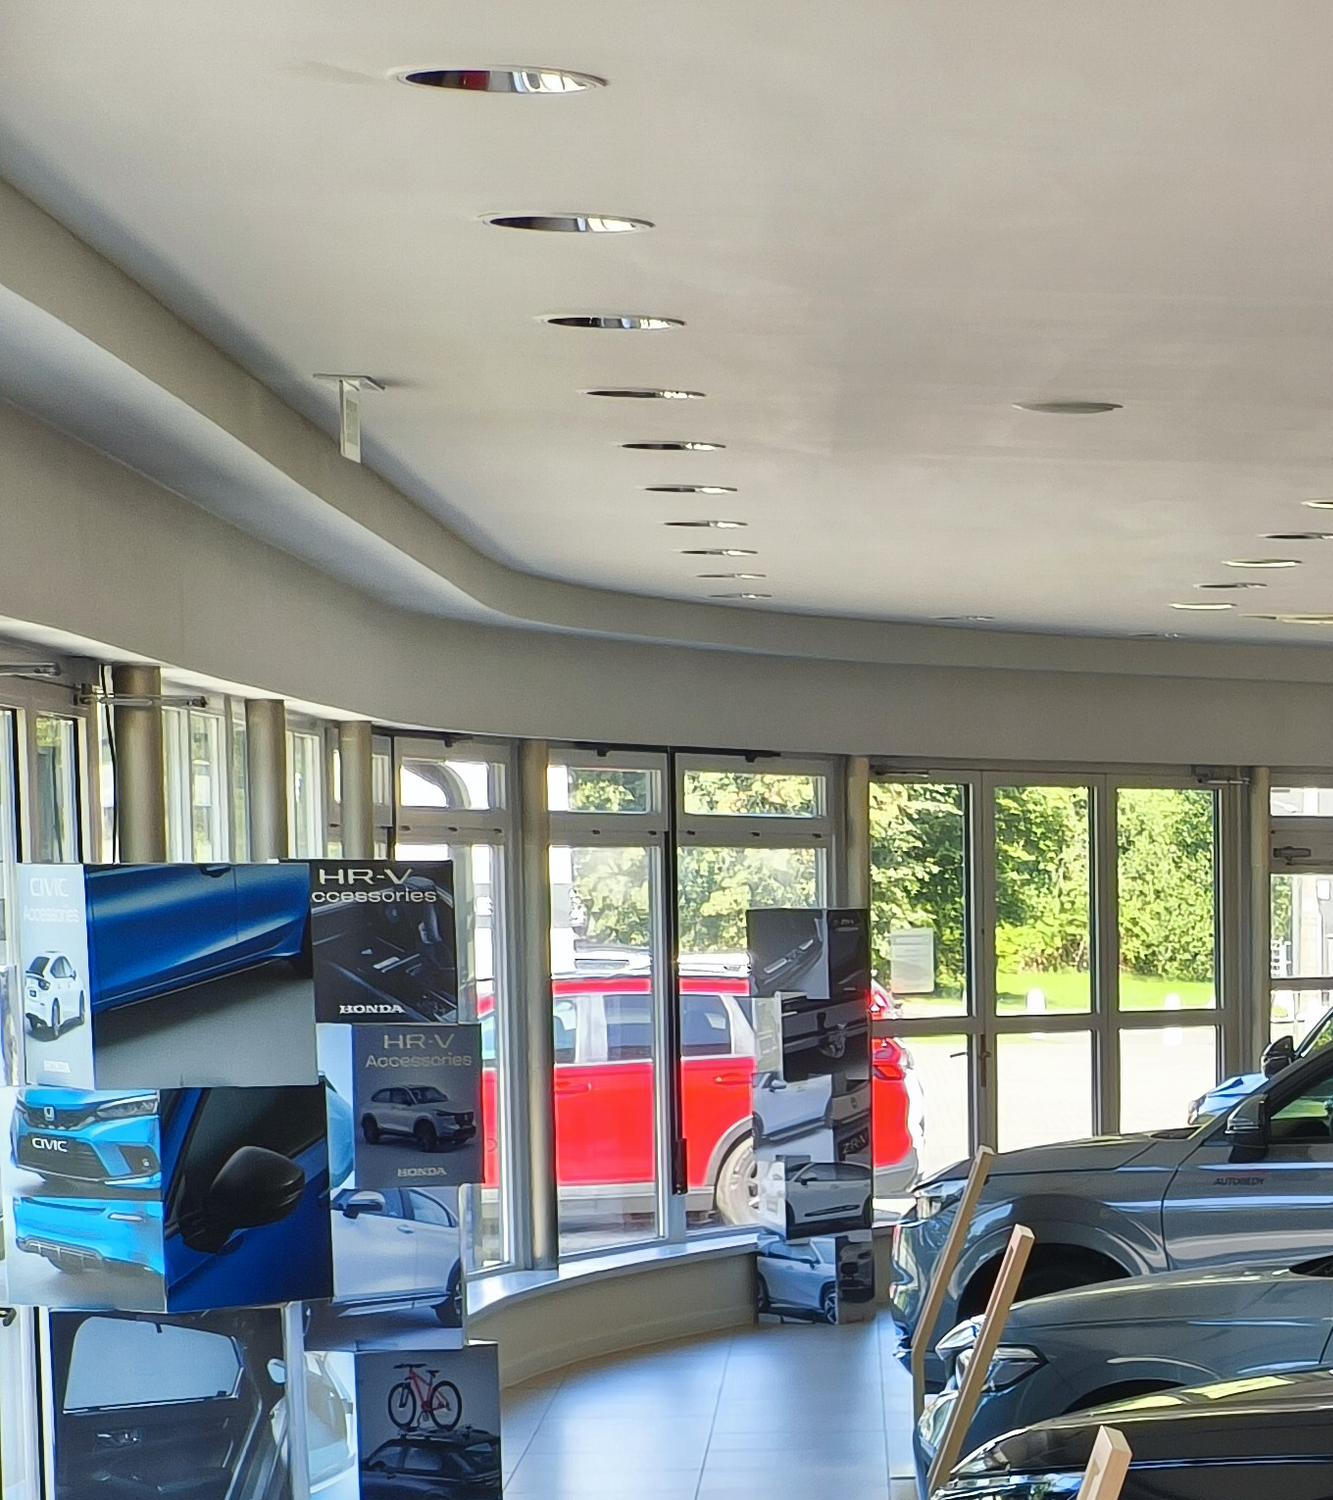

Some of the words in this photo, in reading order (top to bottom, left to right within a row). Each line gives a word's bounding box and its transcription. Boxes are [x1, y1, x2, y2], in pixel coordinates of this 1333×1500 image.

[319, 868, 413, 885] HR-V
[30, 877, 69, 897] CIVIC
[311, 888, 437, 903] ccessories
[339, 1004, 407, 1014] HONDA
[383, 1034, 455, 1049] HR-V
[365, 1052, 472, 1068] Accessories
[32, 1137, 68, 1152] CIVIC
[397, 1167, 448, 1178] HONDA
